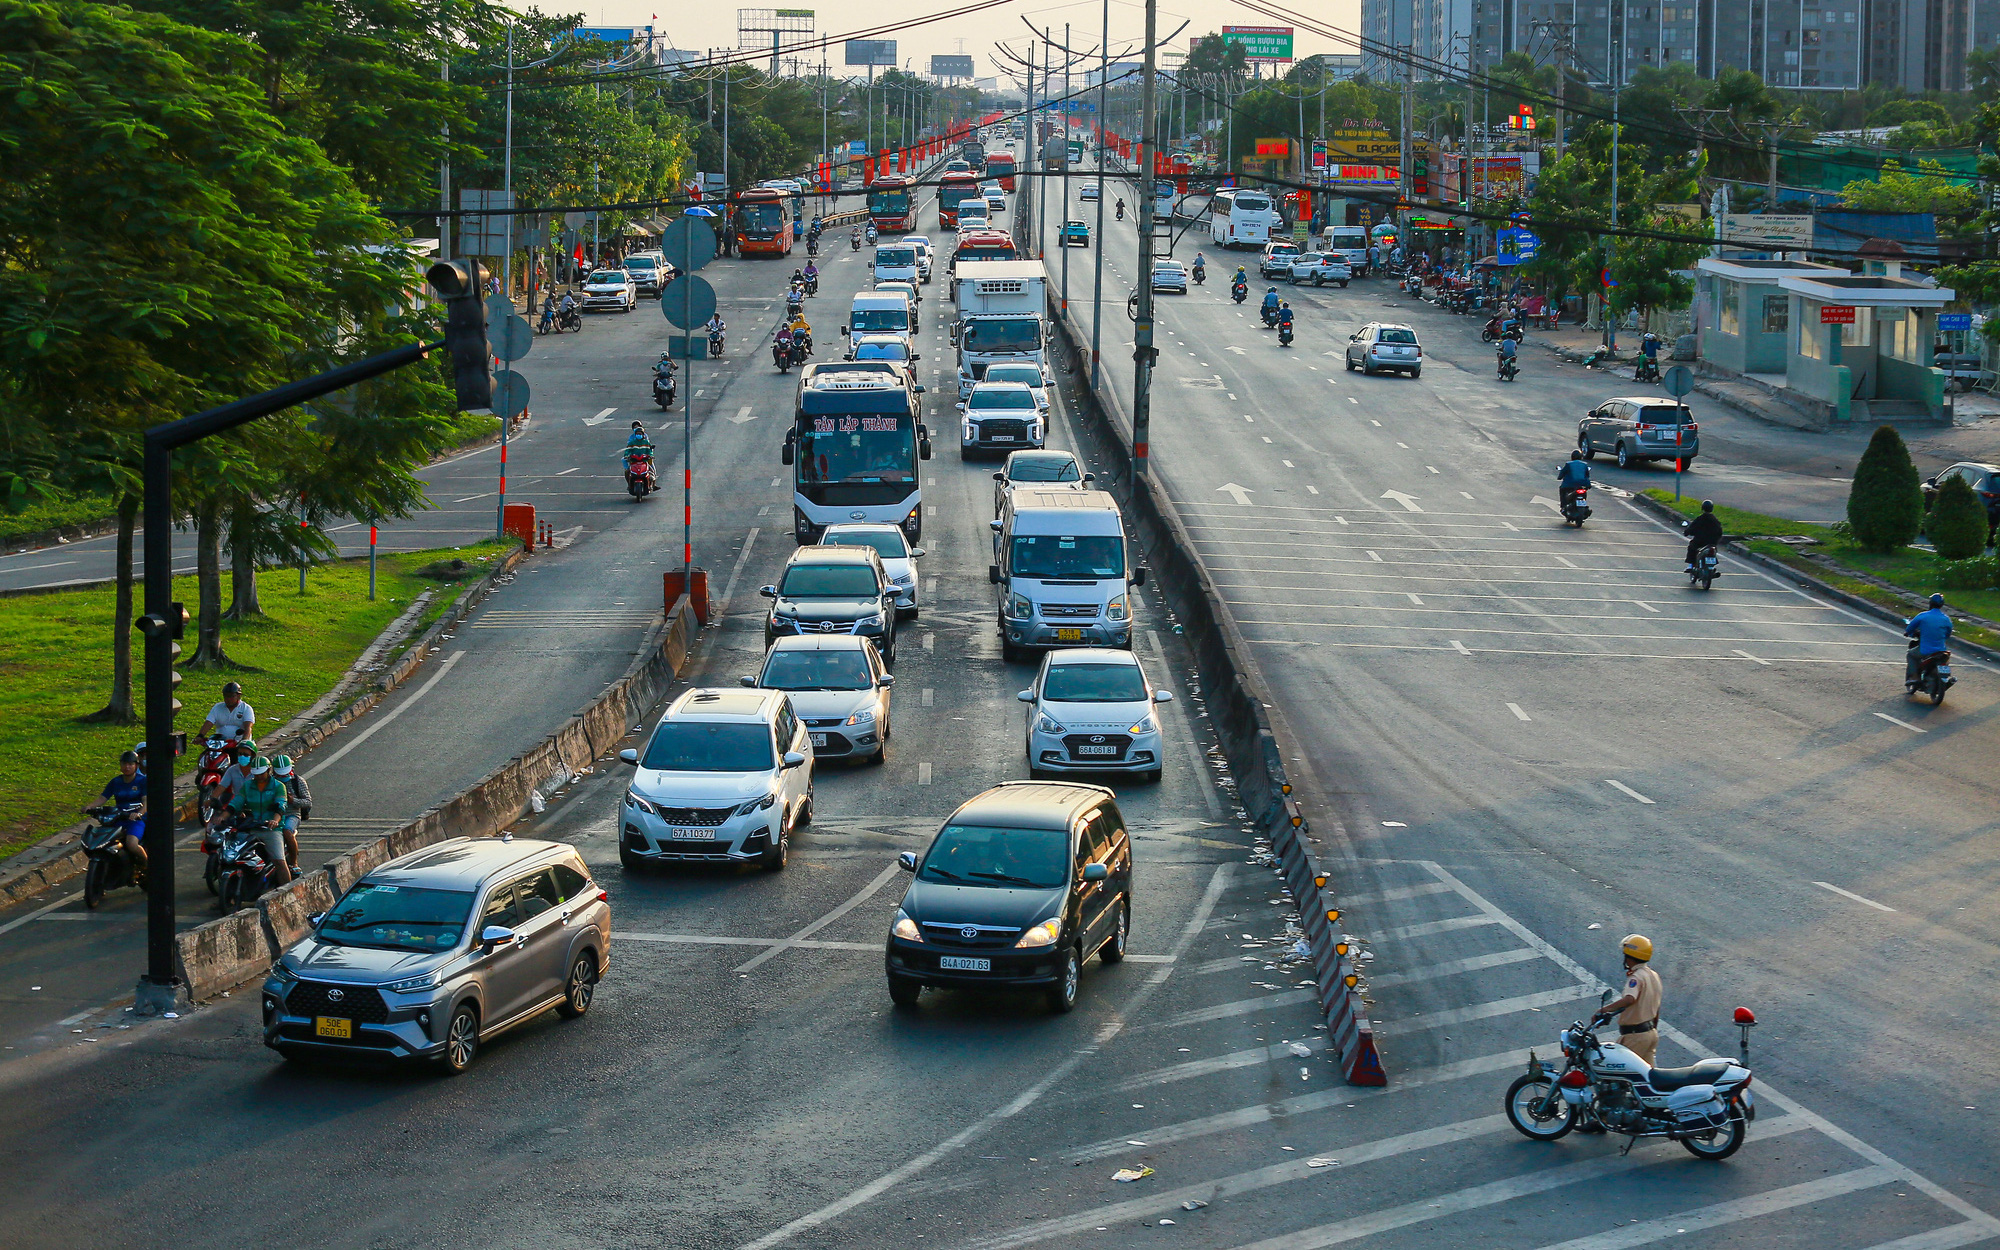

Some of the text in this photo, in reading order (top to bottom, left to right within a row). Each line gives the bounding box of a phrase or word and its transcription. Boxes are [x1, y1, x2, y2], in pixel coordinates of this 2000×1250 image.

[1342, 166, 1378, 178] MINH
[814, 414, 898, 434] TÂN LẬP THÀNH
[942, 958, 989, 970] 84A-021.63
[326, 1019, 342, 1028] 50E
[320, 1027, 348, 1037] 060.03
